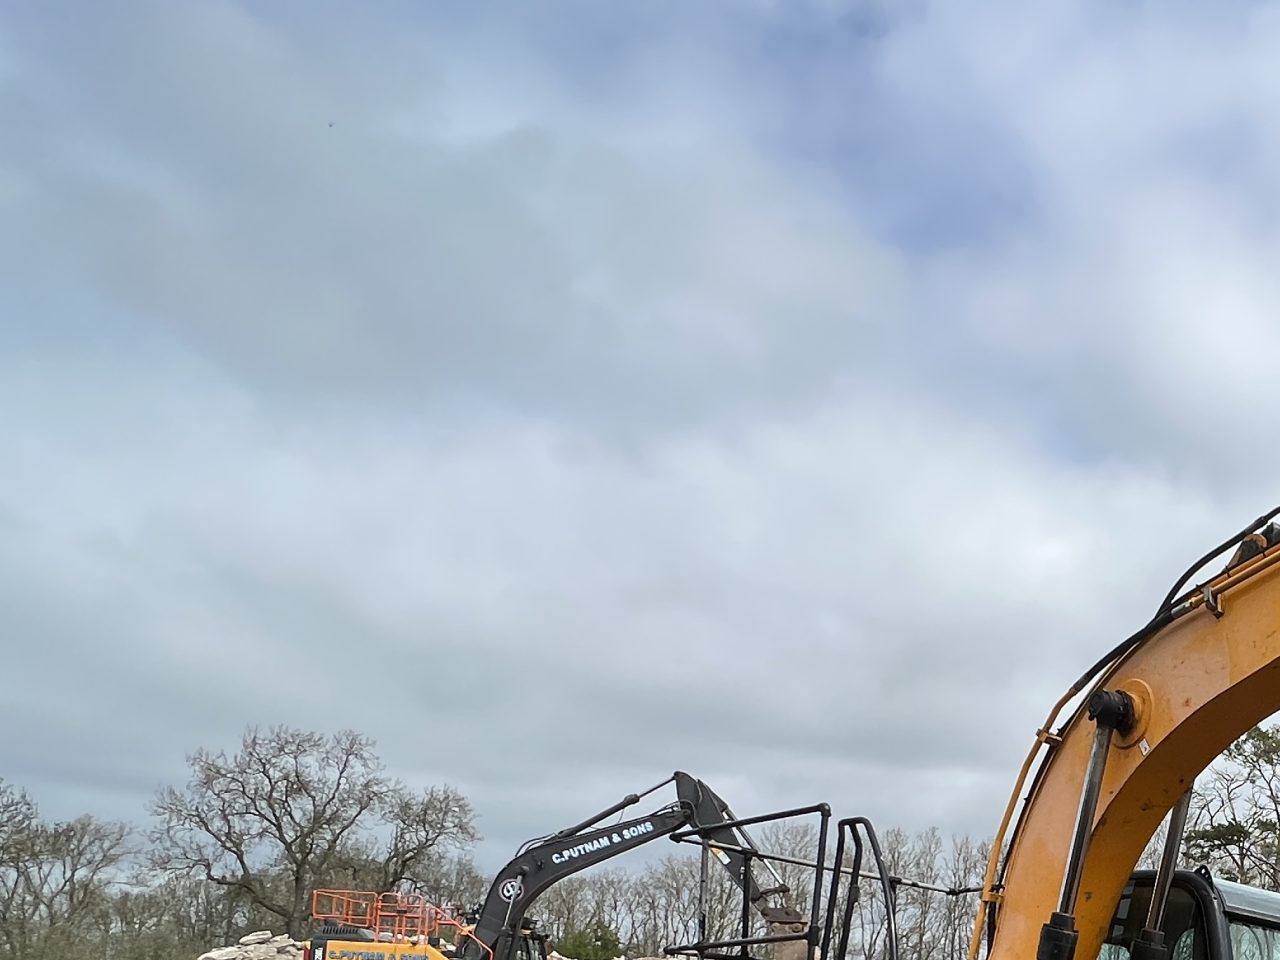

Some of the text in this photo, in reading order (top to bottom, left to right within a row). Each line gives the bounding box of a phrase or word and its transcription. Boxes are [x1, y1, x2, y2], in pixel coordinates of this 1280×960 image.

[551, 821, 654, 864] C.PUTNAM & SONS
